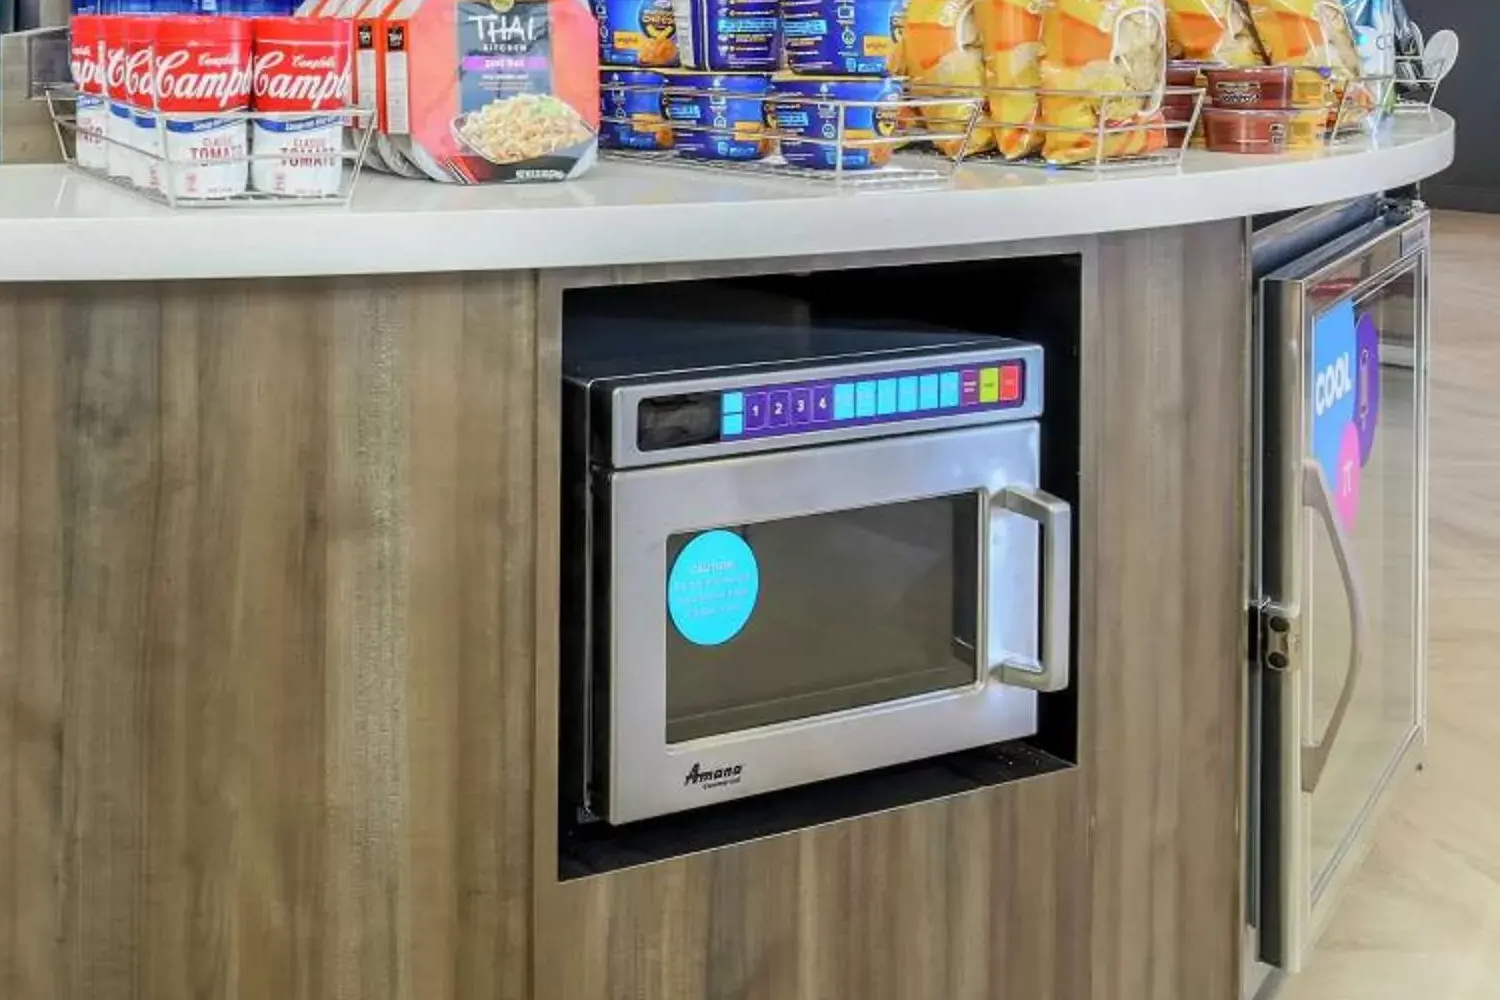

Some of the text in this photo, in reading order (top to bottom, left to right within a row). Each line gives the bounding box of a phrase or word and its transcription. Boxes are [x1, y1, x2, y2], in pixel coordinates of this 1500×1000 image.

[468, 14, 535, 43] THAI
[483, 43, 528, 52] KITCHEN
[1316, 352, 1352, 416] COOL
[751, 397, 827, 417] 1 2 3 4
[684, 762, 743, 786] Amana
